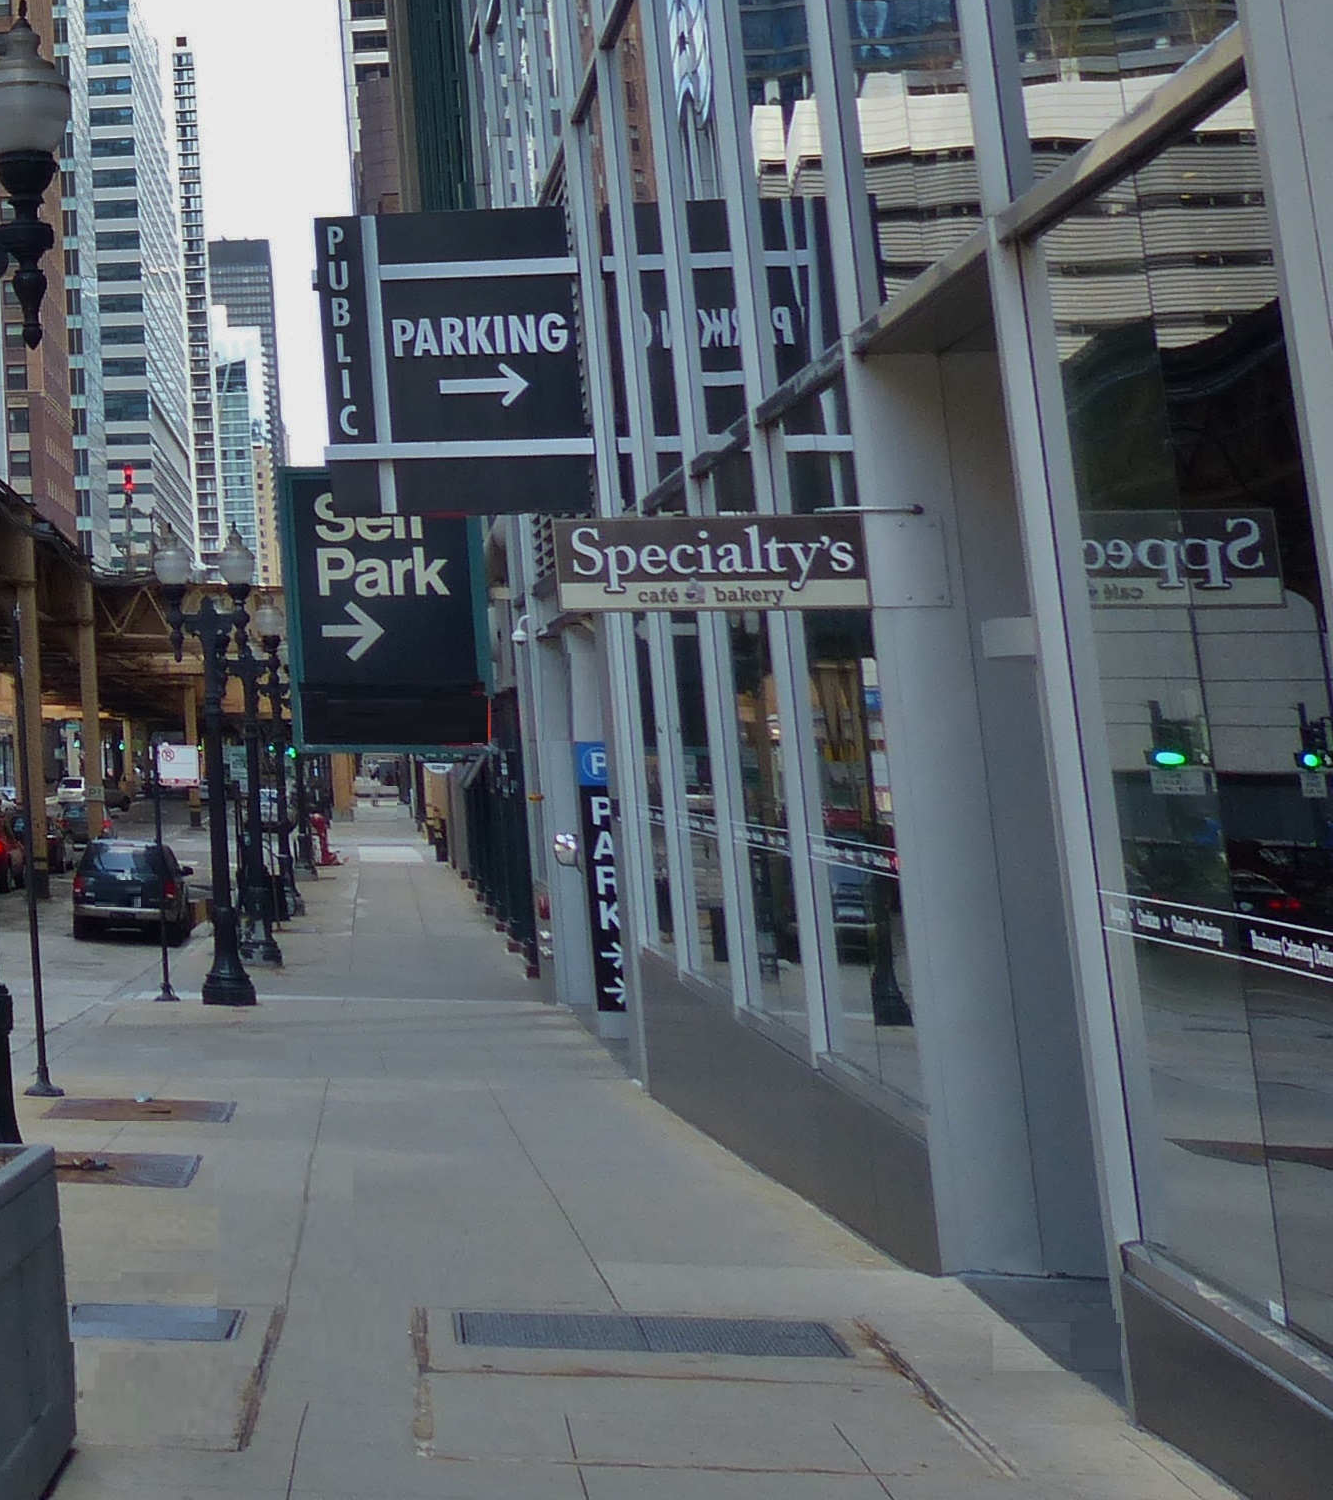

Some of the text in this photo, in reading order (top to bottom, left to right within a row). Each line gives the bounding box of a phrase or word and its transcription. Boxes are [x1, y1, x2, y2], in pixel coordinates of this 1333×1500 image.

[326, 226, 359, 436] PUBLIC
[391, 312, 569, 357] PARKING
[316, 547, 451, 597] Park
[571, 524, 856, 593] Specialty's
[637, 587, 784, 605] café bakery
[591, 796, 621, 930] PARK
